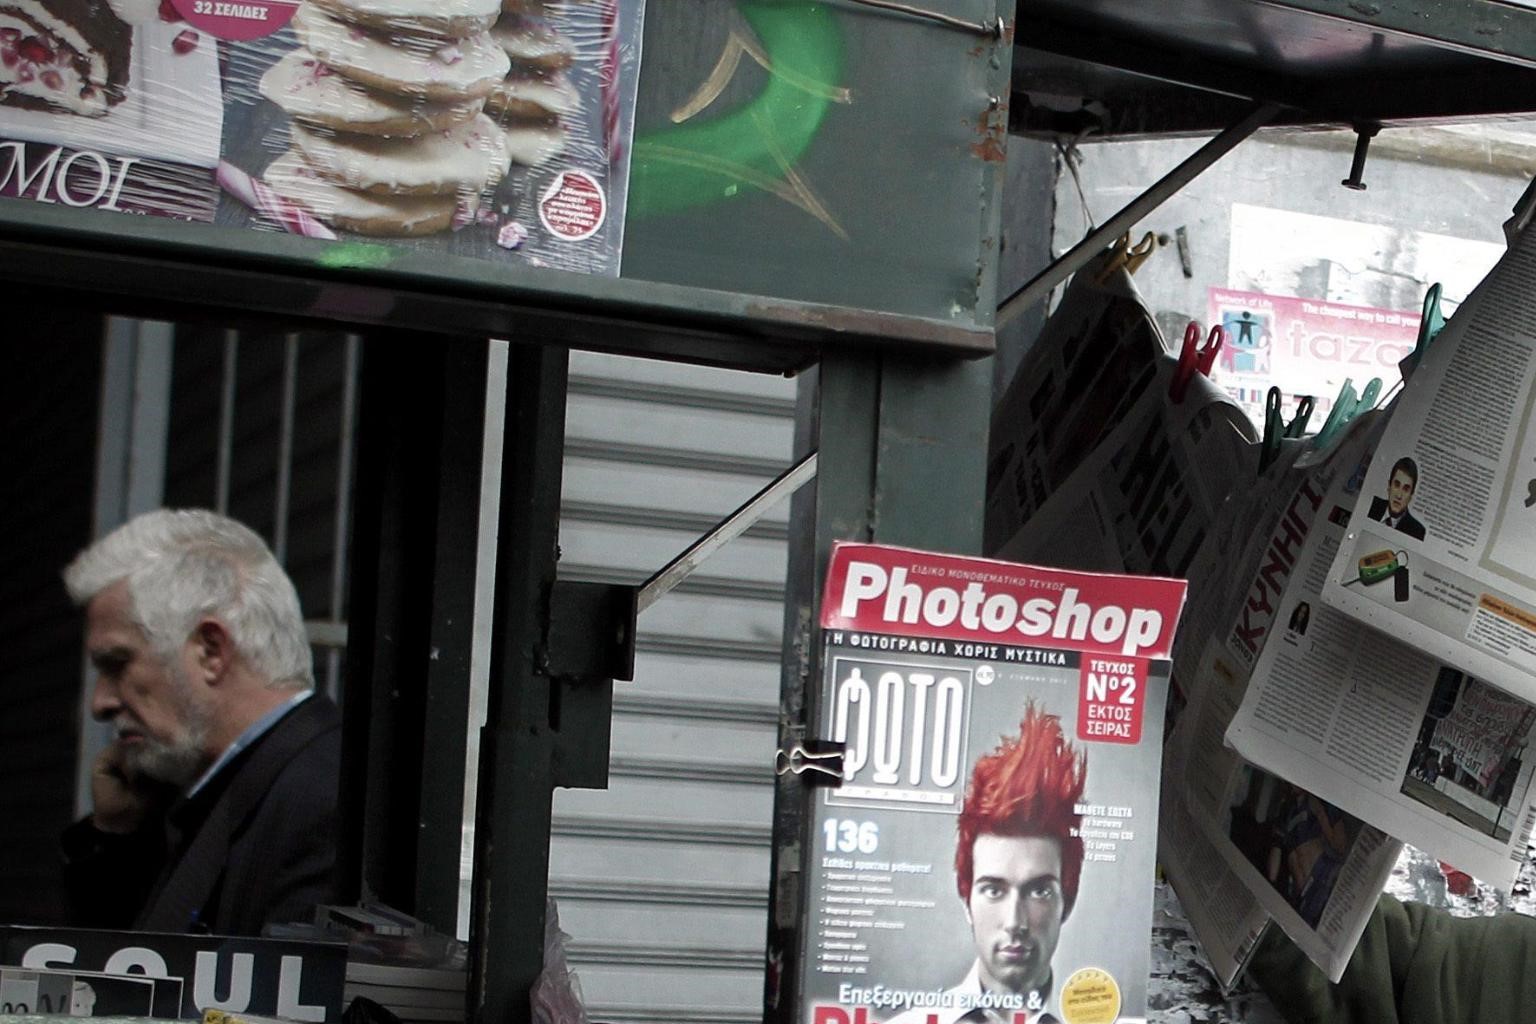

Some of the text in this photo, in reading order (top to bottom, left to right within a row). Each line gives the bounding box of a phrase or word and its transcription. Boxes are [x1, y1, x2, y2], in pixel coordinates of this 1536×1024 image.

[194, 1, 269, 20] 32 ΣΕΛΙΔΕΣ
[1302, 302, 1319, 315] The
[1319, 306, 1357, 321] cheapest
[1357, 313, 1375, 323] way
[1375, 312, 1385, 323] to
[911, 563, 1067, 592] ΕΙΔΙΚΟ ΜΟΝΟΘΕΜΑΤΙΚΟ ΤΕΥΧΟΣ
[840, 561, 1164, 656] Photoshop
[833, 631, 1067, 666] Η ΦΩΤΟΓΡΑΦΙΑ ΧΩΡΙΣ ΜΥΣΤΙΚΑ
[1090, 659, 1136, 676] ΤΕΥΧΟΣ
[1087, 703, 1133, 722] ΕΚΤΟΣ
[1086, 720, 1132, 738] ΣΕΙΡΑΣ
[822, 817, 879, 854] 136
[838, 984, 1042, 1010] Επεξεργασία εικόνας &
